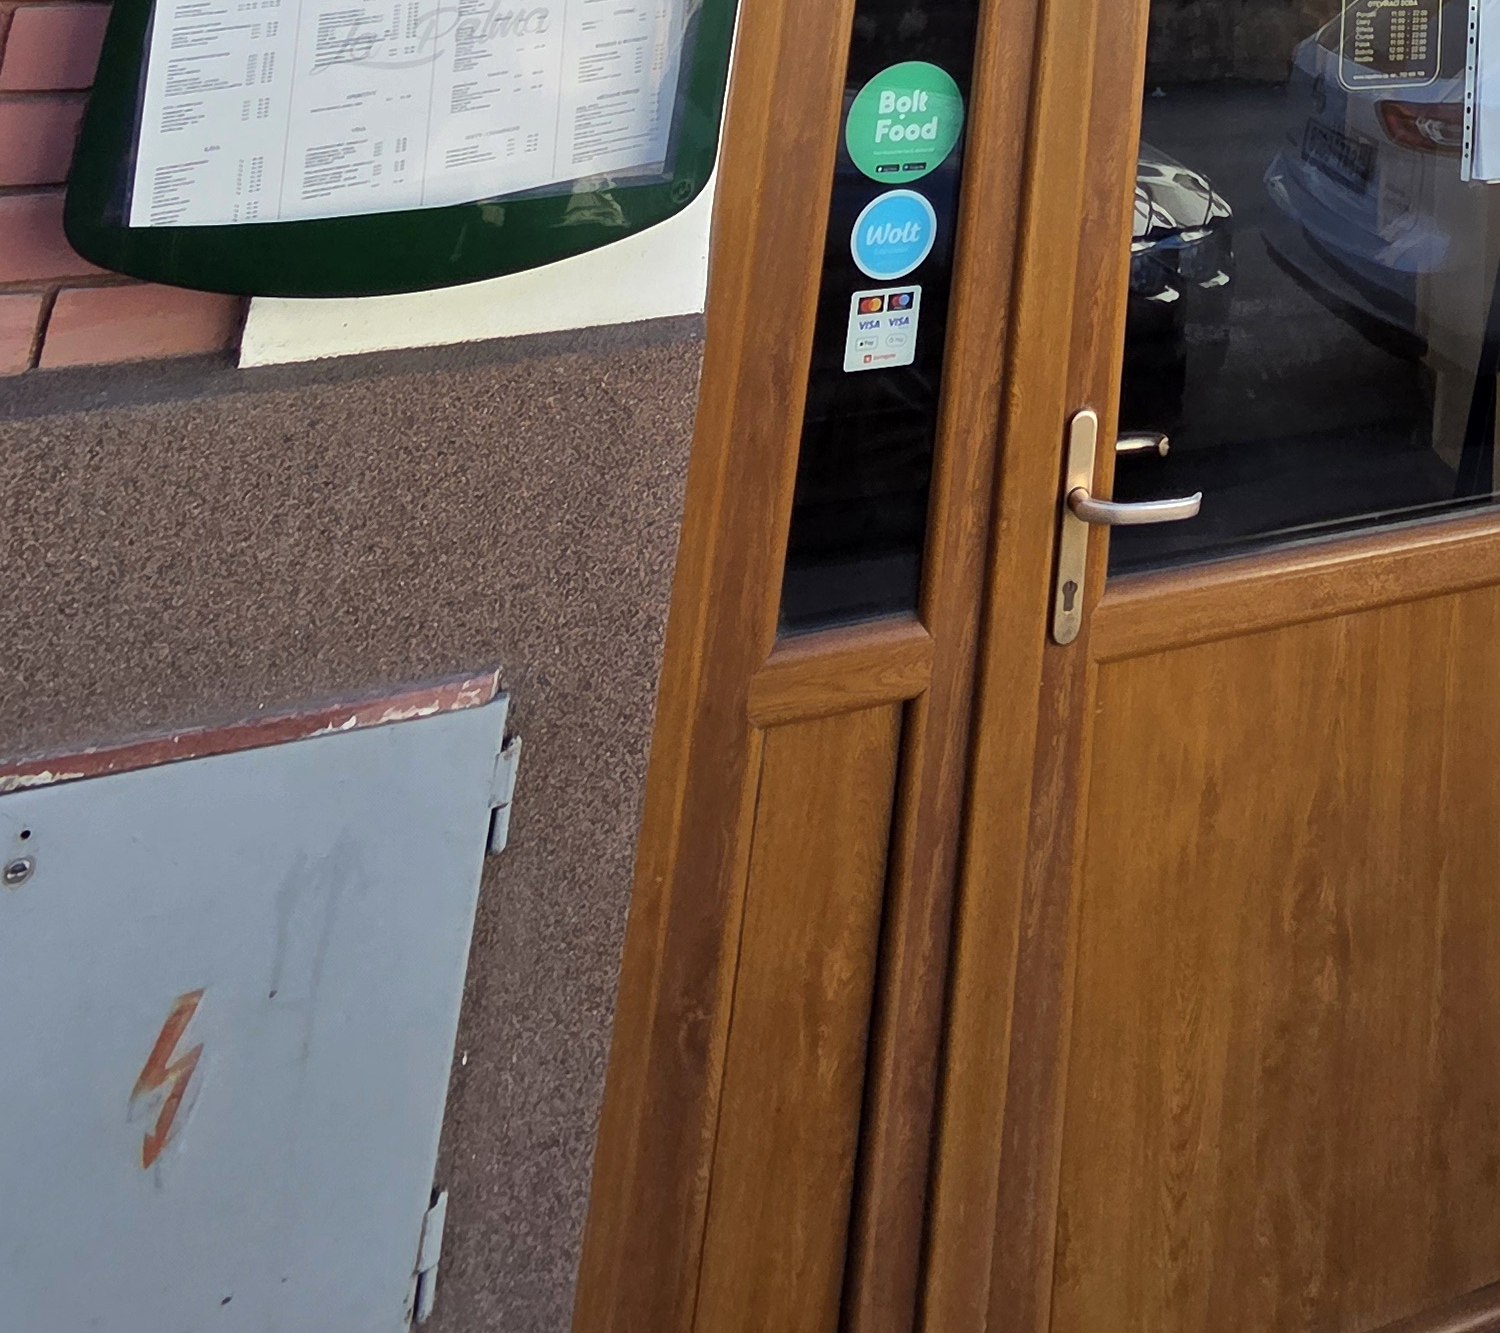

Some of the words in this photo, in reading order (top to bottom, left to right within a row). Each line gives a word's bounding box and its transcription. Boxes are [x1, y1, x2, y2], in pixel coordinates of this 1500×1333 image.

[879, 89, 928, 114] Bolt
[875, 116, 938, 143] Food
[866, 220, 921, 245] Wolt
[859, 320, 880, 330] VISA
[889, 317, 909, 326] VISA
